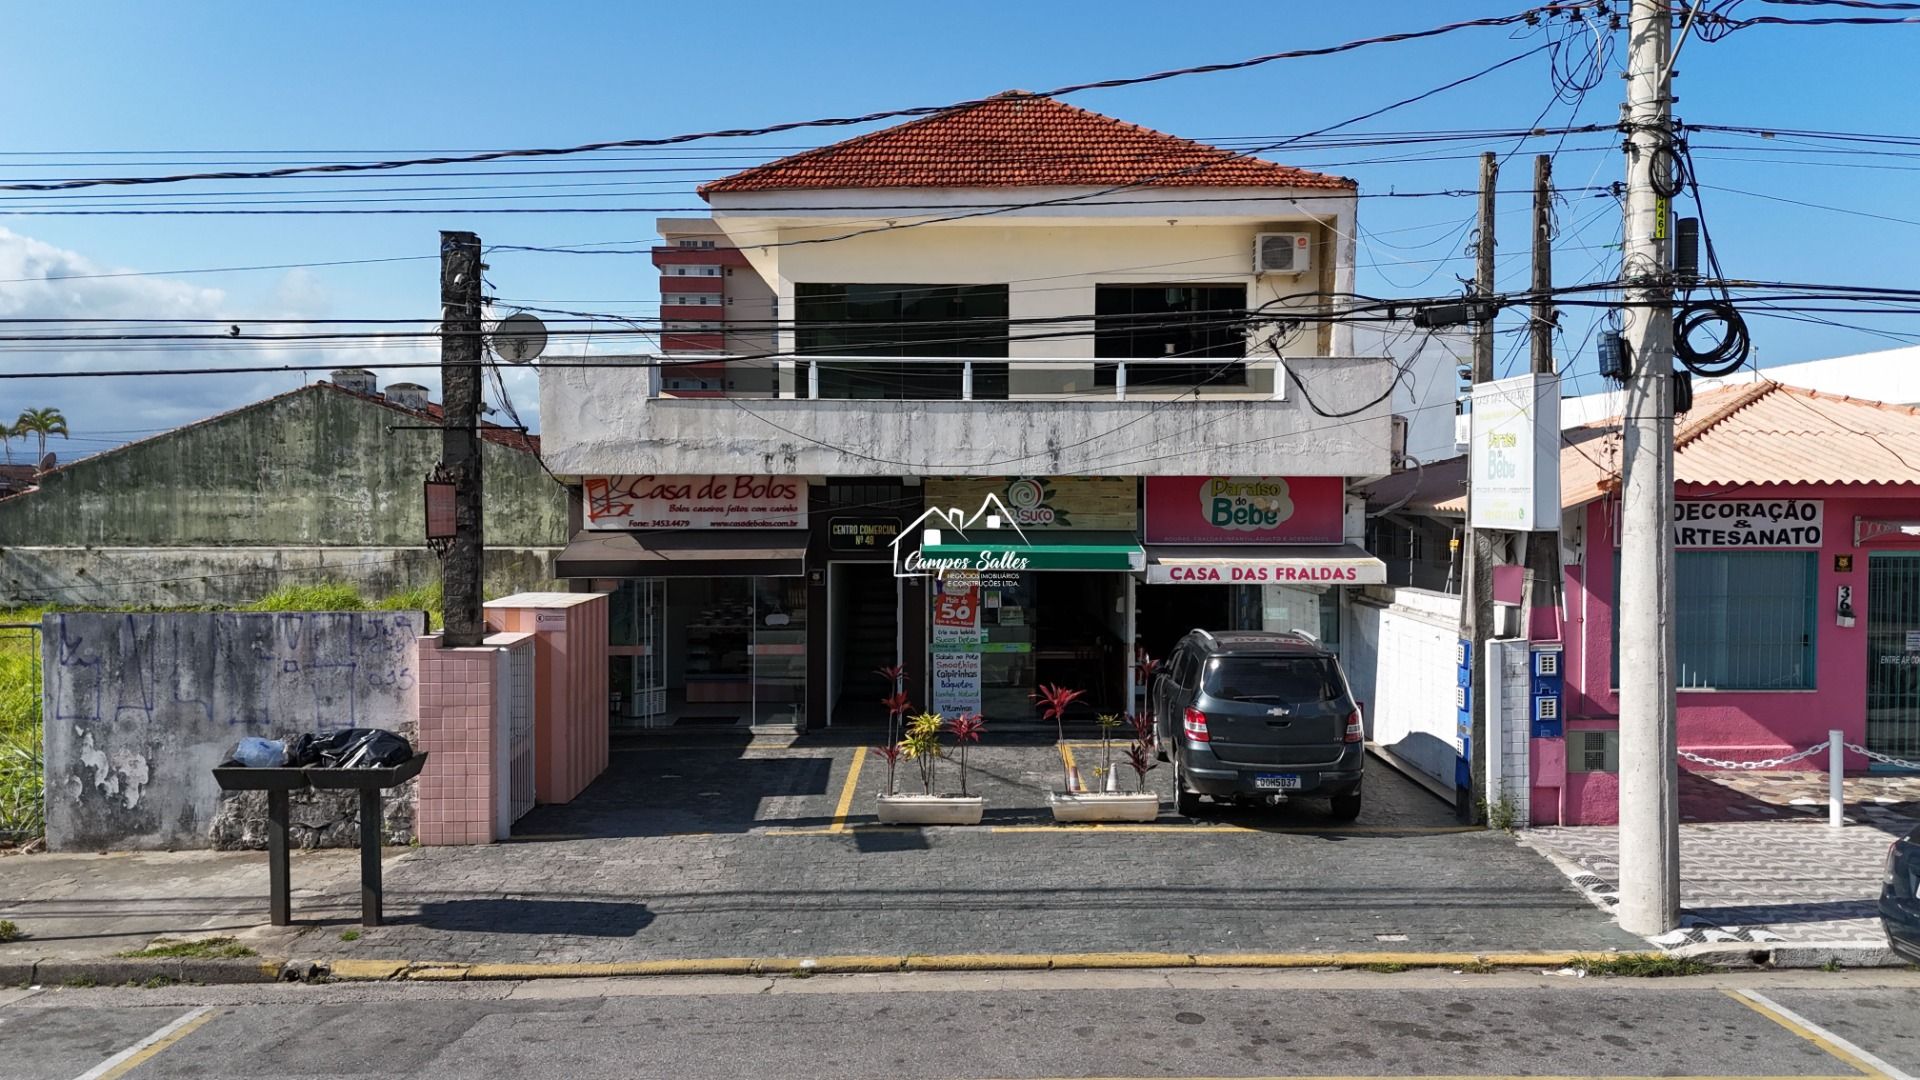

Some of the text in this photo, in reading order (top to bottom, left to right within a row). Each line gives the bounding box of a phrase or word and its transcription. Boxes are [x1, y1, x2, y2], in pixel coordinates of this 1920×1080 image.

[628, 476, 797, 500] Casa de Bolos
[1211, 477, 1281, 497] Paraíso
[1235, 497, 1247, 506] do
[669, 504, 690, 513] Bolos
[692, 504, 724, 513] caseiros
[725, 504, 748, 517] feitos
[1020, 509, 1053, 522] SUCO
[1674, 500, 1817, 522] DECORAÇÃO
[832, 524, 897, 536] CENTRO COMERCIAL
[1733, 520, 1752, 528] &
[1170, 567, 1357, 581] CASA DAS FRALDAS
[941, 602, 970, 620] 50
[1880, 655, 1900, 664] ENTRE
[1901, 655, 1911, 664] AR
